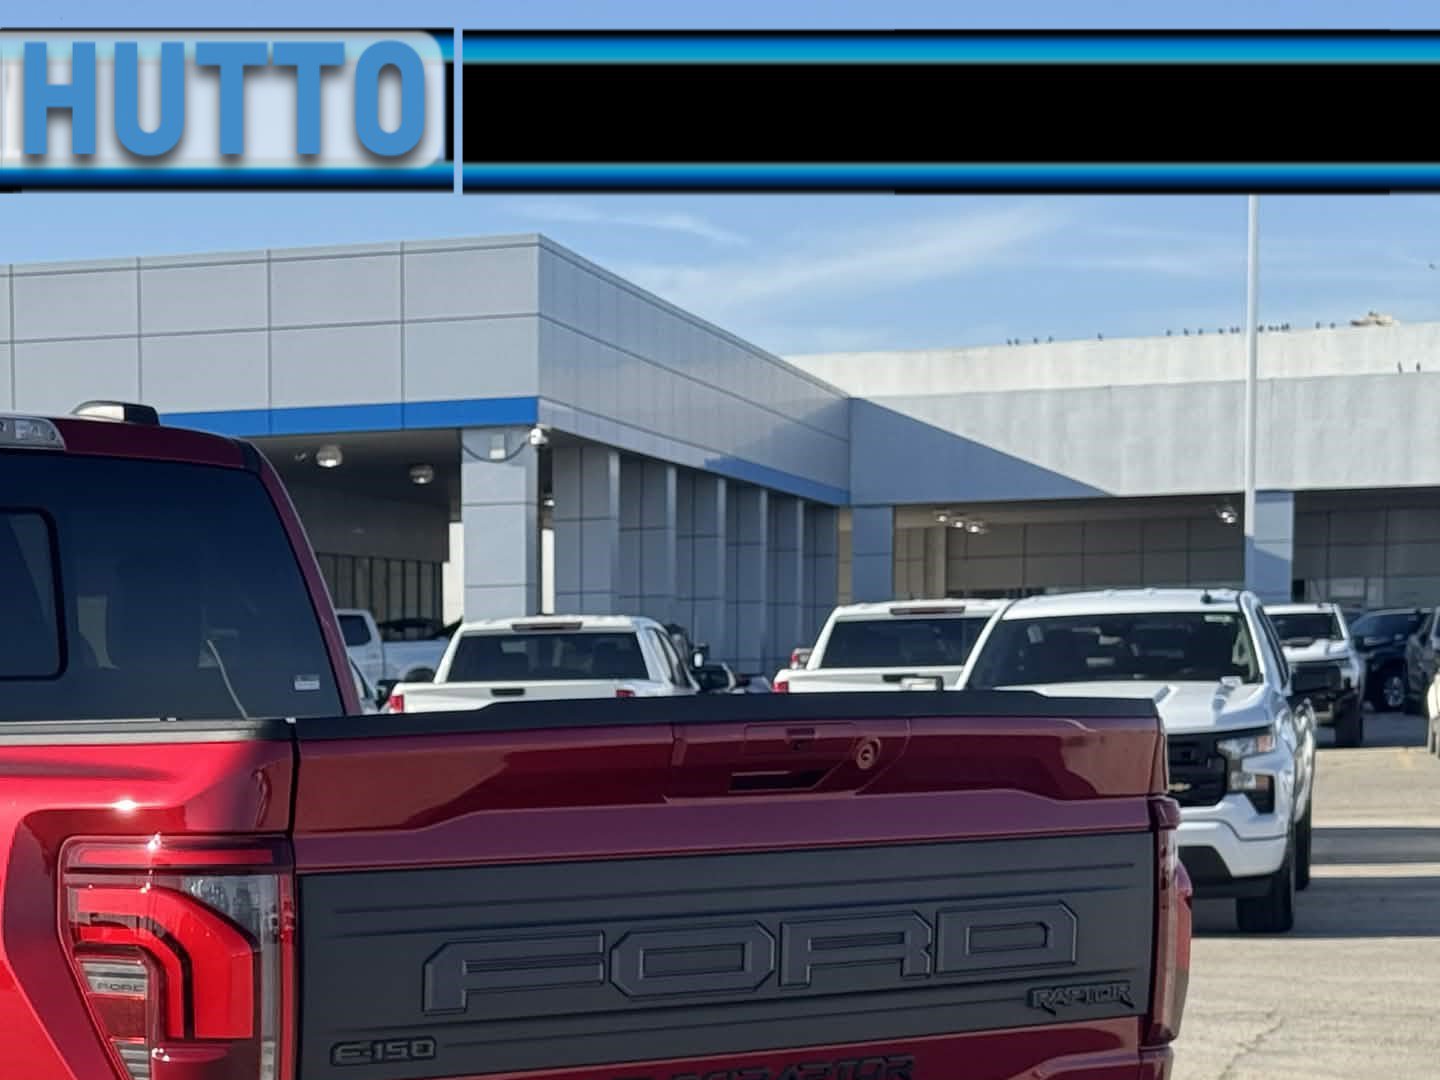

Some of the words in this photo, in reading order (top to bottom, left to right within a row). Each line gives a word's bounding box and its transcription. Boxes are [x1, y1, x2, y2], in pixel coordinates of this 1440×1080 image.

[422, 900, 1078, 1017] FORD
[1027, 980, 1135, 1016] RAPTOR
[330, 1036, 437, 1066] F-150
